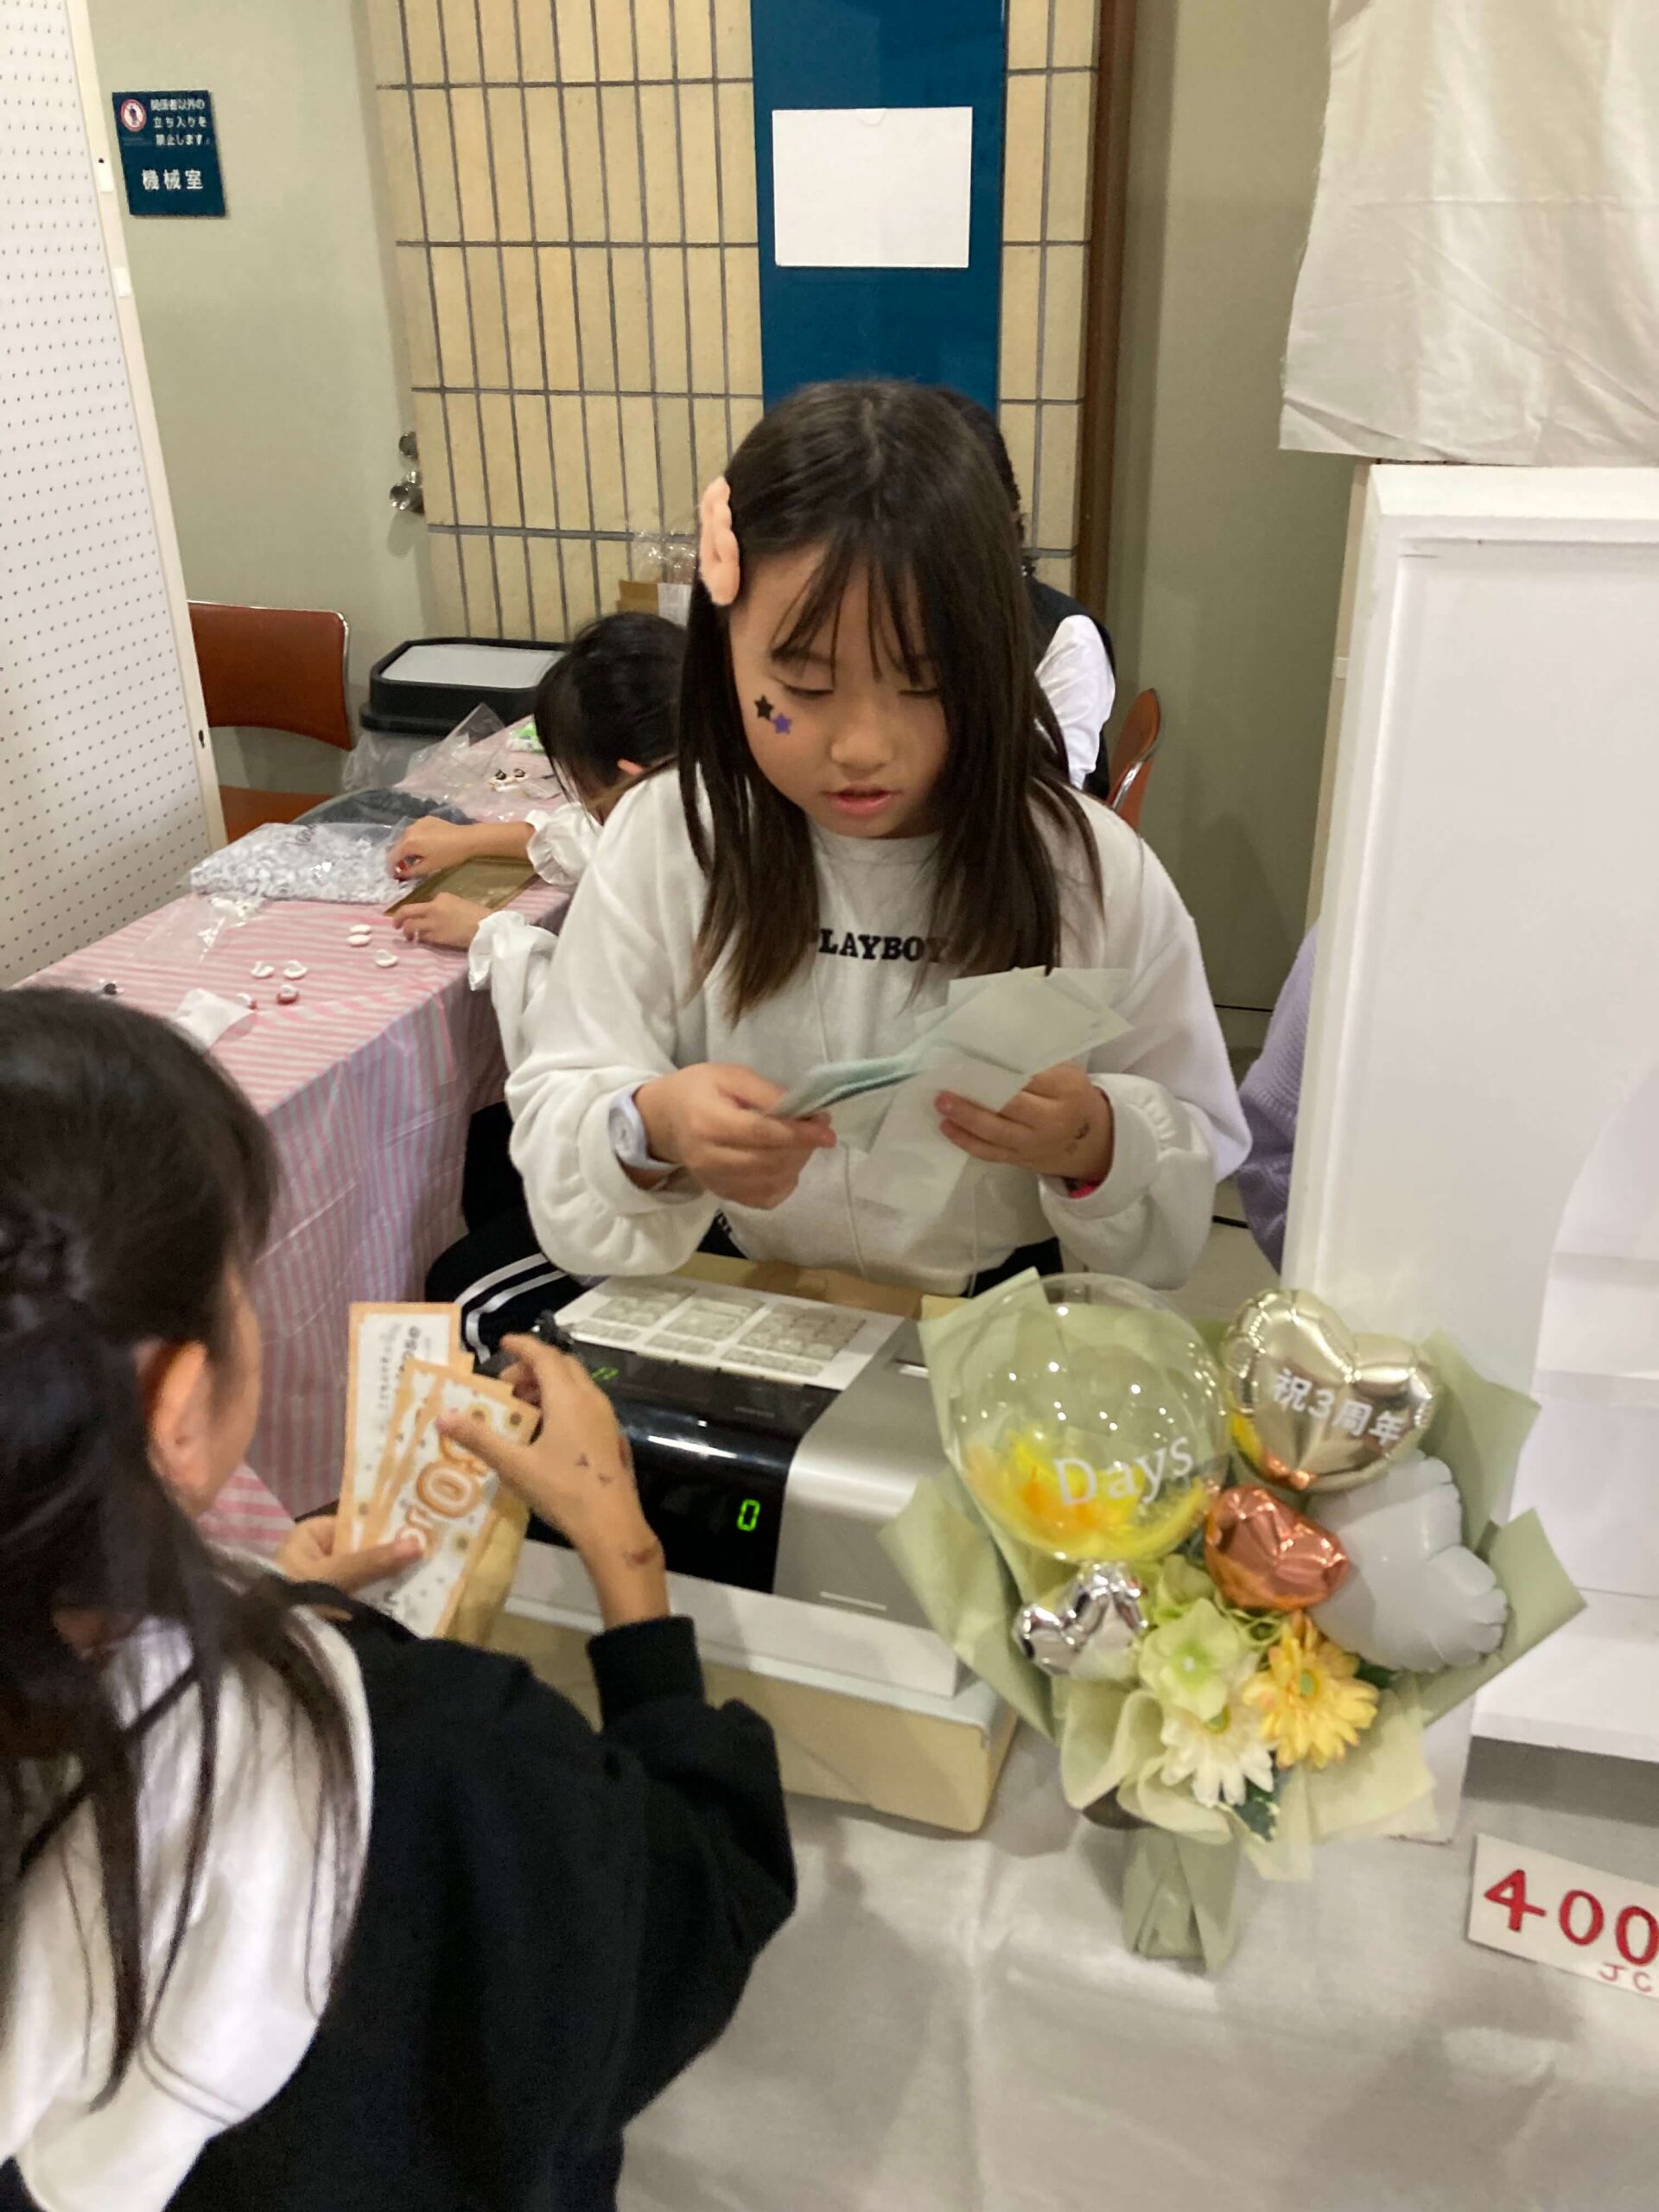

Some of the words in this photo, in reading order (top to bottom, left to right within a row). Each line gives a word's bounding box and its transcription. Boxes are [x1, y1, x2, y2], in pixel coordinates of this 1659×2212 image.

[153, 116, 207, 129] 立ち入りを
[142, 168, 204, 190] 機械室
[817, 928, 950, 963] LAYBOY
[1274, 1367, 1404, 1446] 祝3周年
[1053, 1435, 1194, 1506] Days
[737, 1498, 760, 1532] 0
[1483, 1868, 1659, 1967] 400
